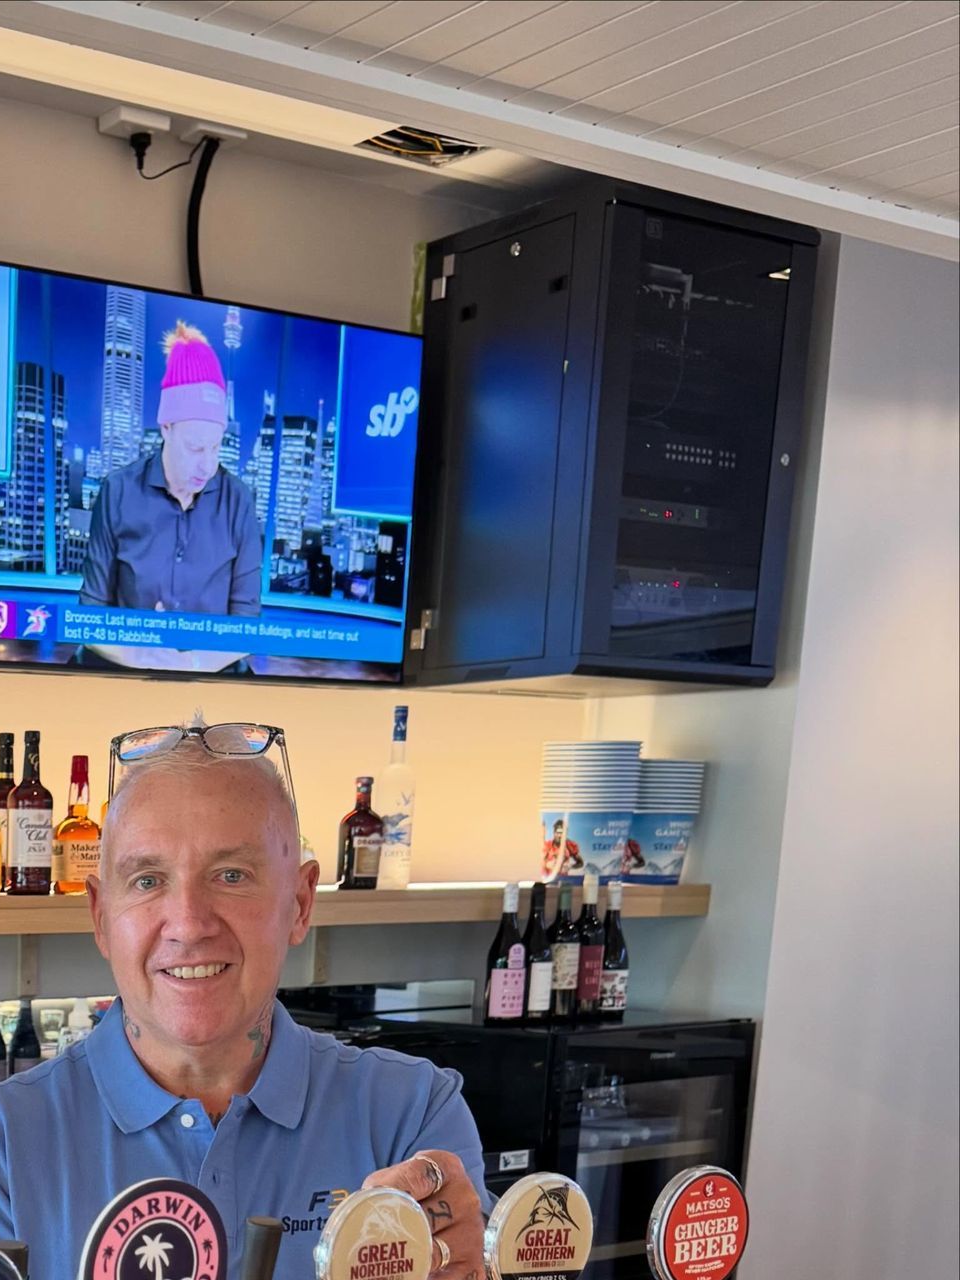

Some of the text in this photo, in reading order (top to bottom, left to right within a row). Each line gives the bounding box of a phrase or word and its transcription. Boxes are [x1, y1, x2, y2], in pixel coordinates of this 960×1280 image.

[64, 609, 104, 625] Broncos:
[105, 613, 125, 626] Last
[126, 614, 141, 626] win
[143, 617, 167, 629] came
[178, 618, 205, 631] Round
[213, 622, 243, 635] against
[64, 626, 83, 639] lost
[107, 629, 117, 641] to
[113, 1195, 206, 1239] DARWIN
[685, 1196, 731, 1216] MATSO'S
[525, 1228, 572, 1248] GREAT
[673, 1215, 739, 1242] GINGER
[357, 1240, 408, 1265] GREAT
[516, 1246, 576, 1262] NORTHERN
[673, 1233, 738, 1265] BEER
[350, 1258, 414, 1280] NORTHERN
